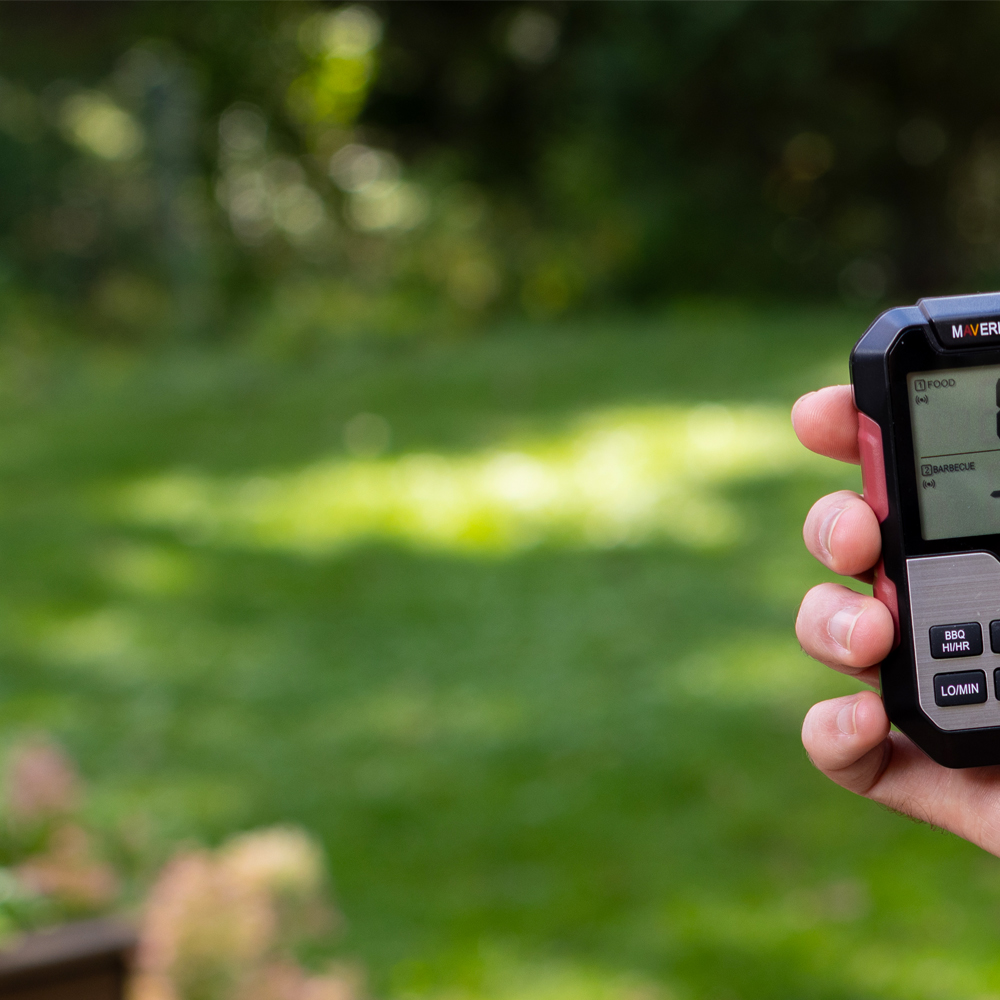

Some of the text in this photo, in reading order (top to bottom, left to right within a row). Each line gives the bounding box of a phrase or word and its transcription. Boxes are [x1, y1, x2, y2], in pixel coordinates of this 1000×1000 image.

[927, 378, 956, 389] FOOD
[933, 461, 976, 474] BARBECUE
[944, 629, 966, 641] BBQ
[942, 640, 970, 652] HI/HR
[940, 682, 980, 697] LO/MIN
